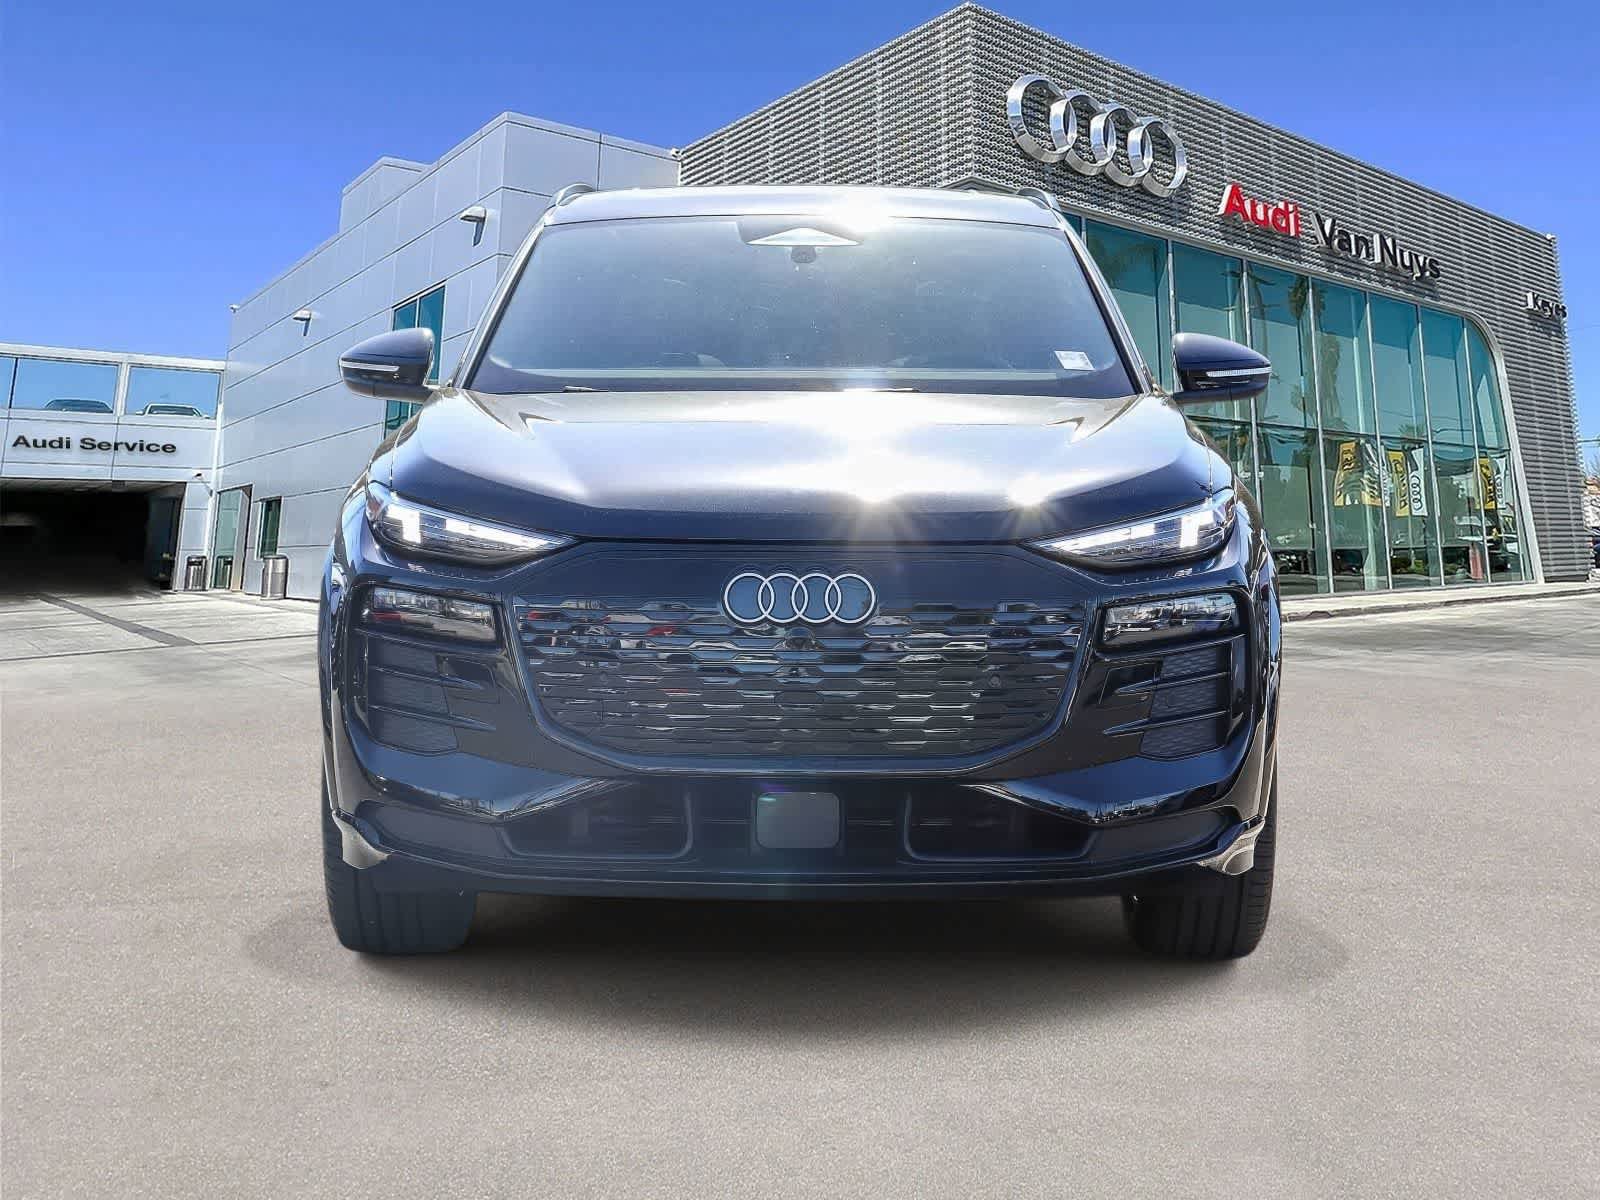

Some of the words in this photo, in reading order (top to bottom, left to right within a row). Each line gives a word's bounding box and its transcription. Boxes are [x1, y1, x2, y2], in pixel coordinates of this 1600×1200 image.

[1217, 182, 1301, 238] Audi
[1311, 213, 1373, 260] Van
[1374, 233, 1440, 280] Nuys
[1528, 291, 1567, 318] Keyes
[12, 435, 71, 449] Audi
[79, 437, 177, 454] Service
